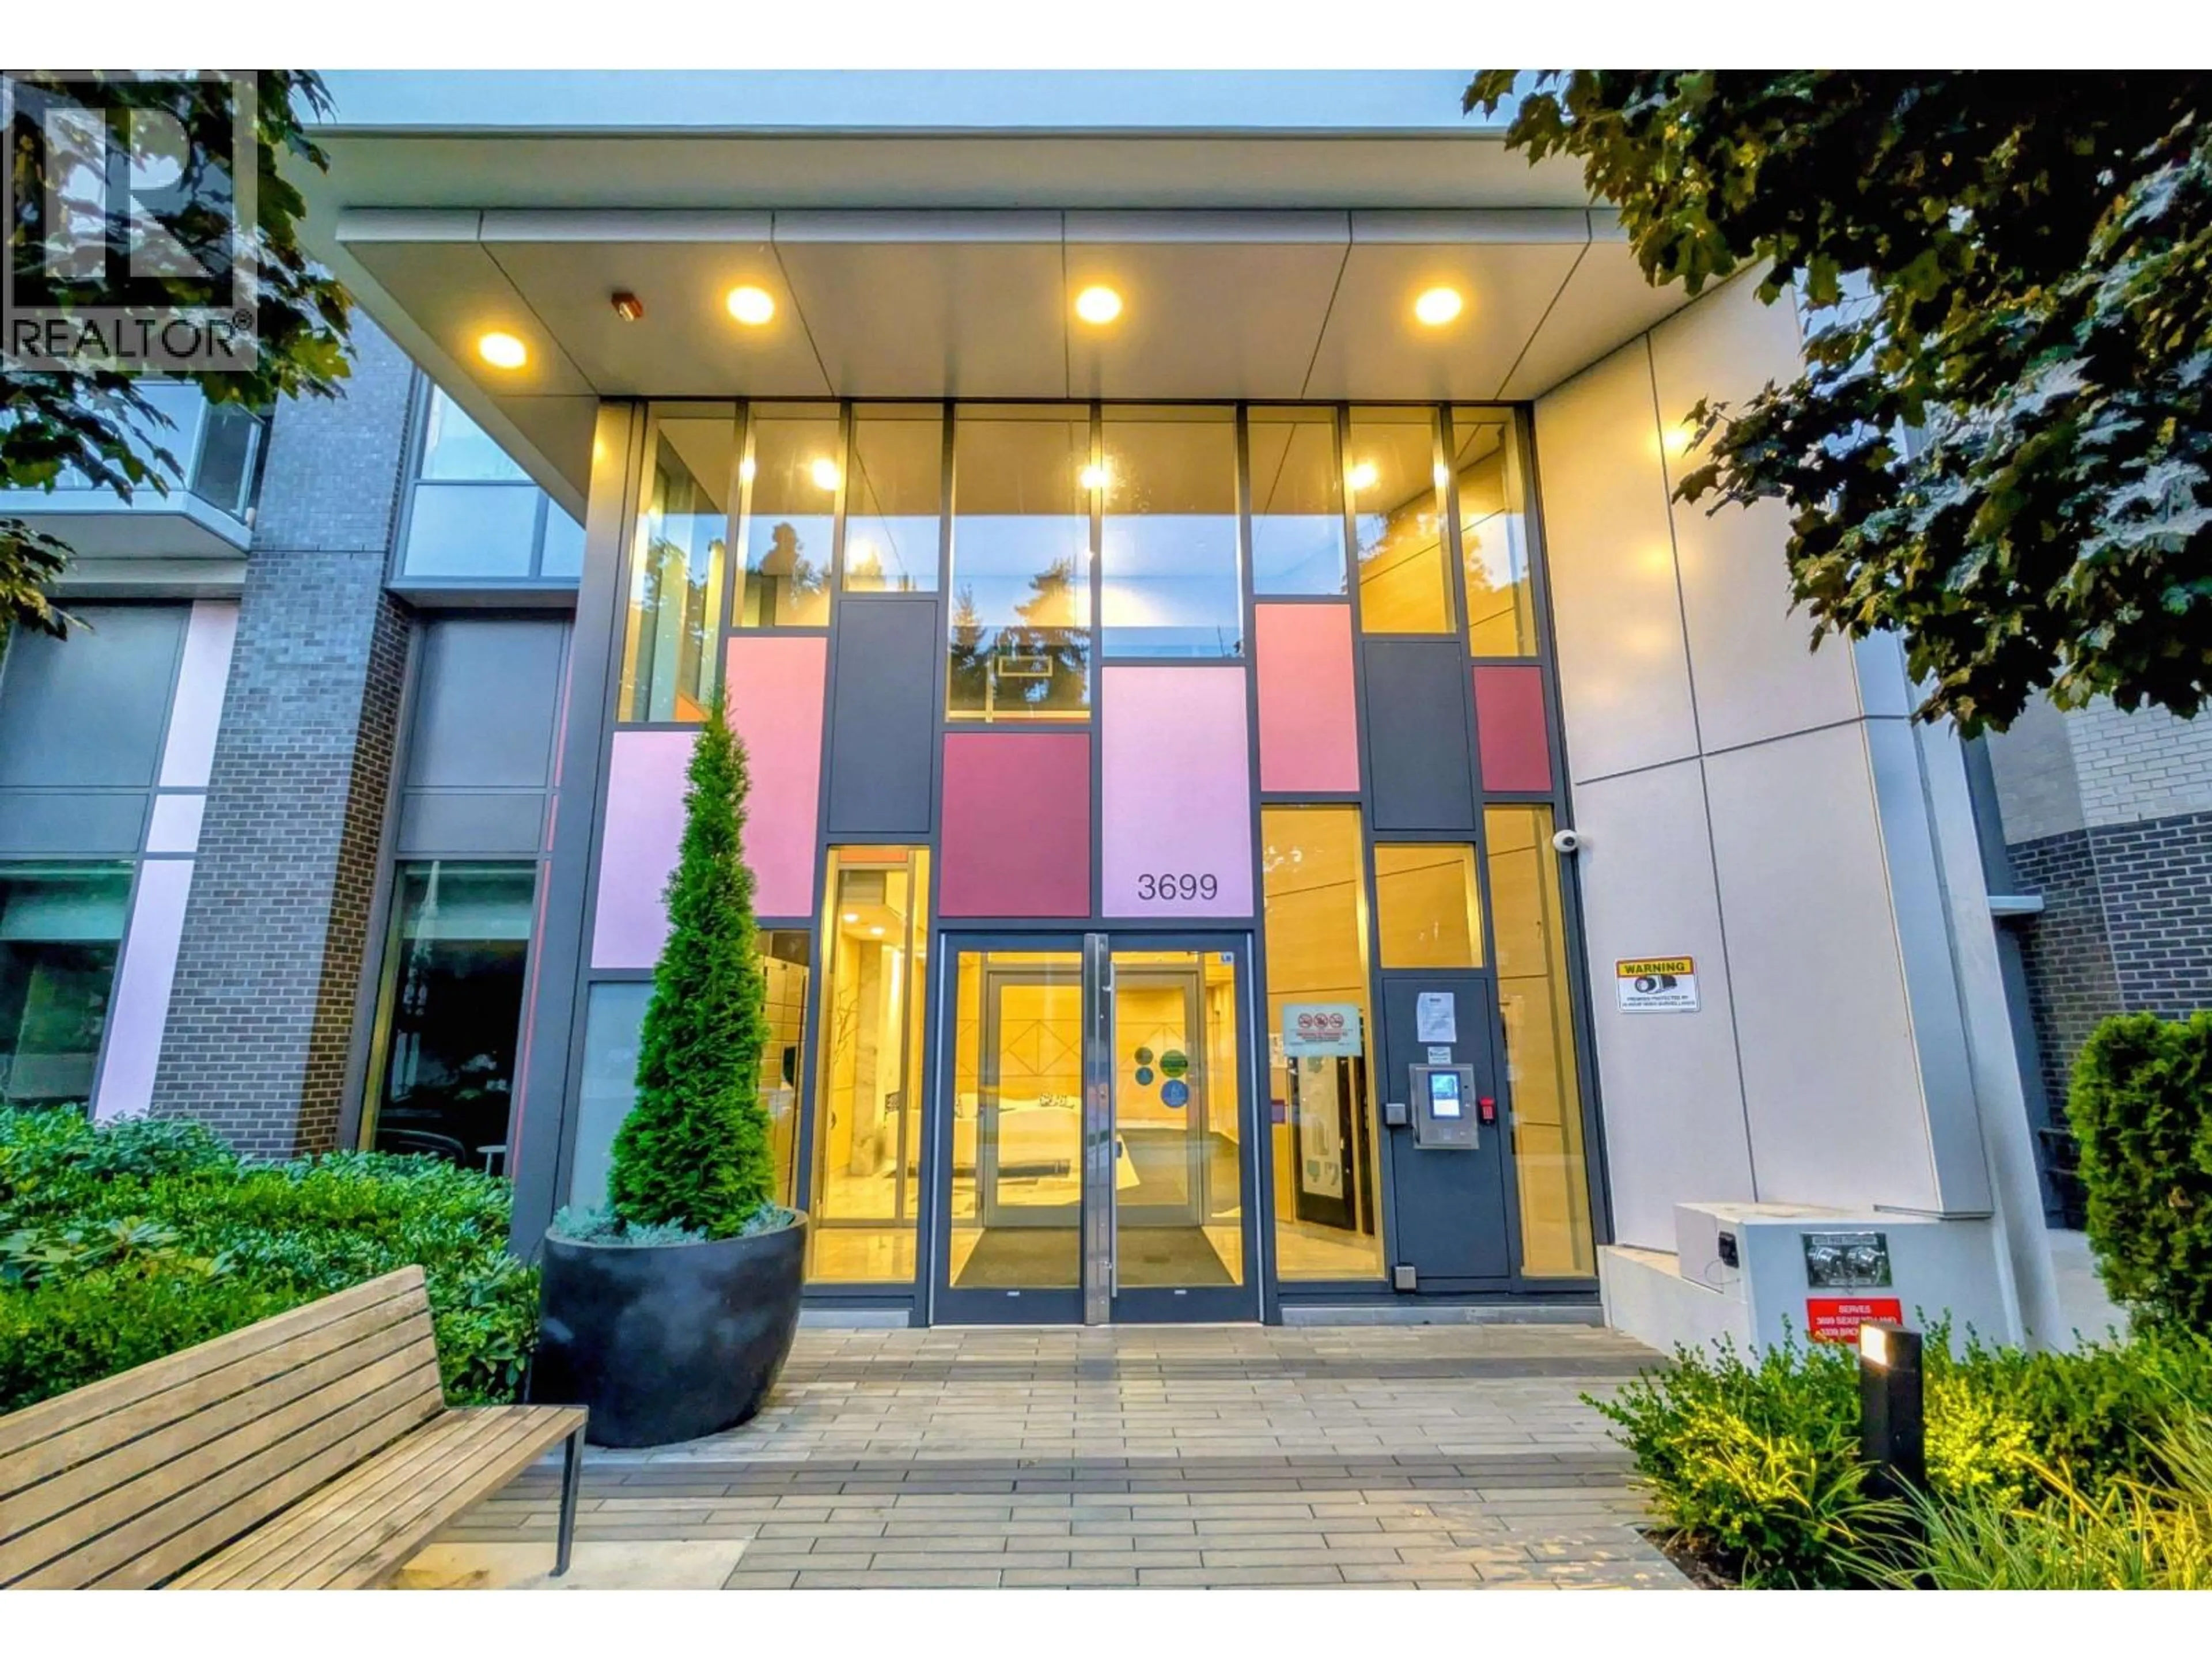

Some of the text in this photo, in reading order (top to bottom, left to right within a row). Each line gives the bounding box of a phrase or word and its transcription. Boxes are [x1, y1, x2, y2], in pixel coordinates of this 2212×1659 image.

[1138, 873, 1218, 900] 3699
[1624, 962, 1685, 974] WARNING
[1838, 1305, 1872, 1313] SERVES
